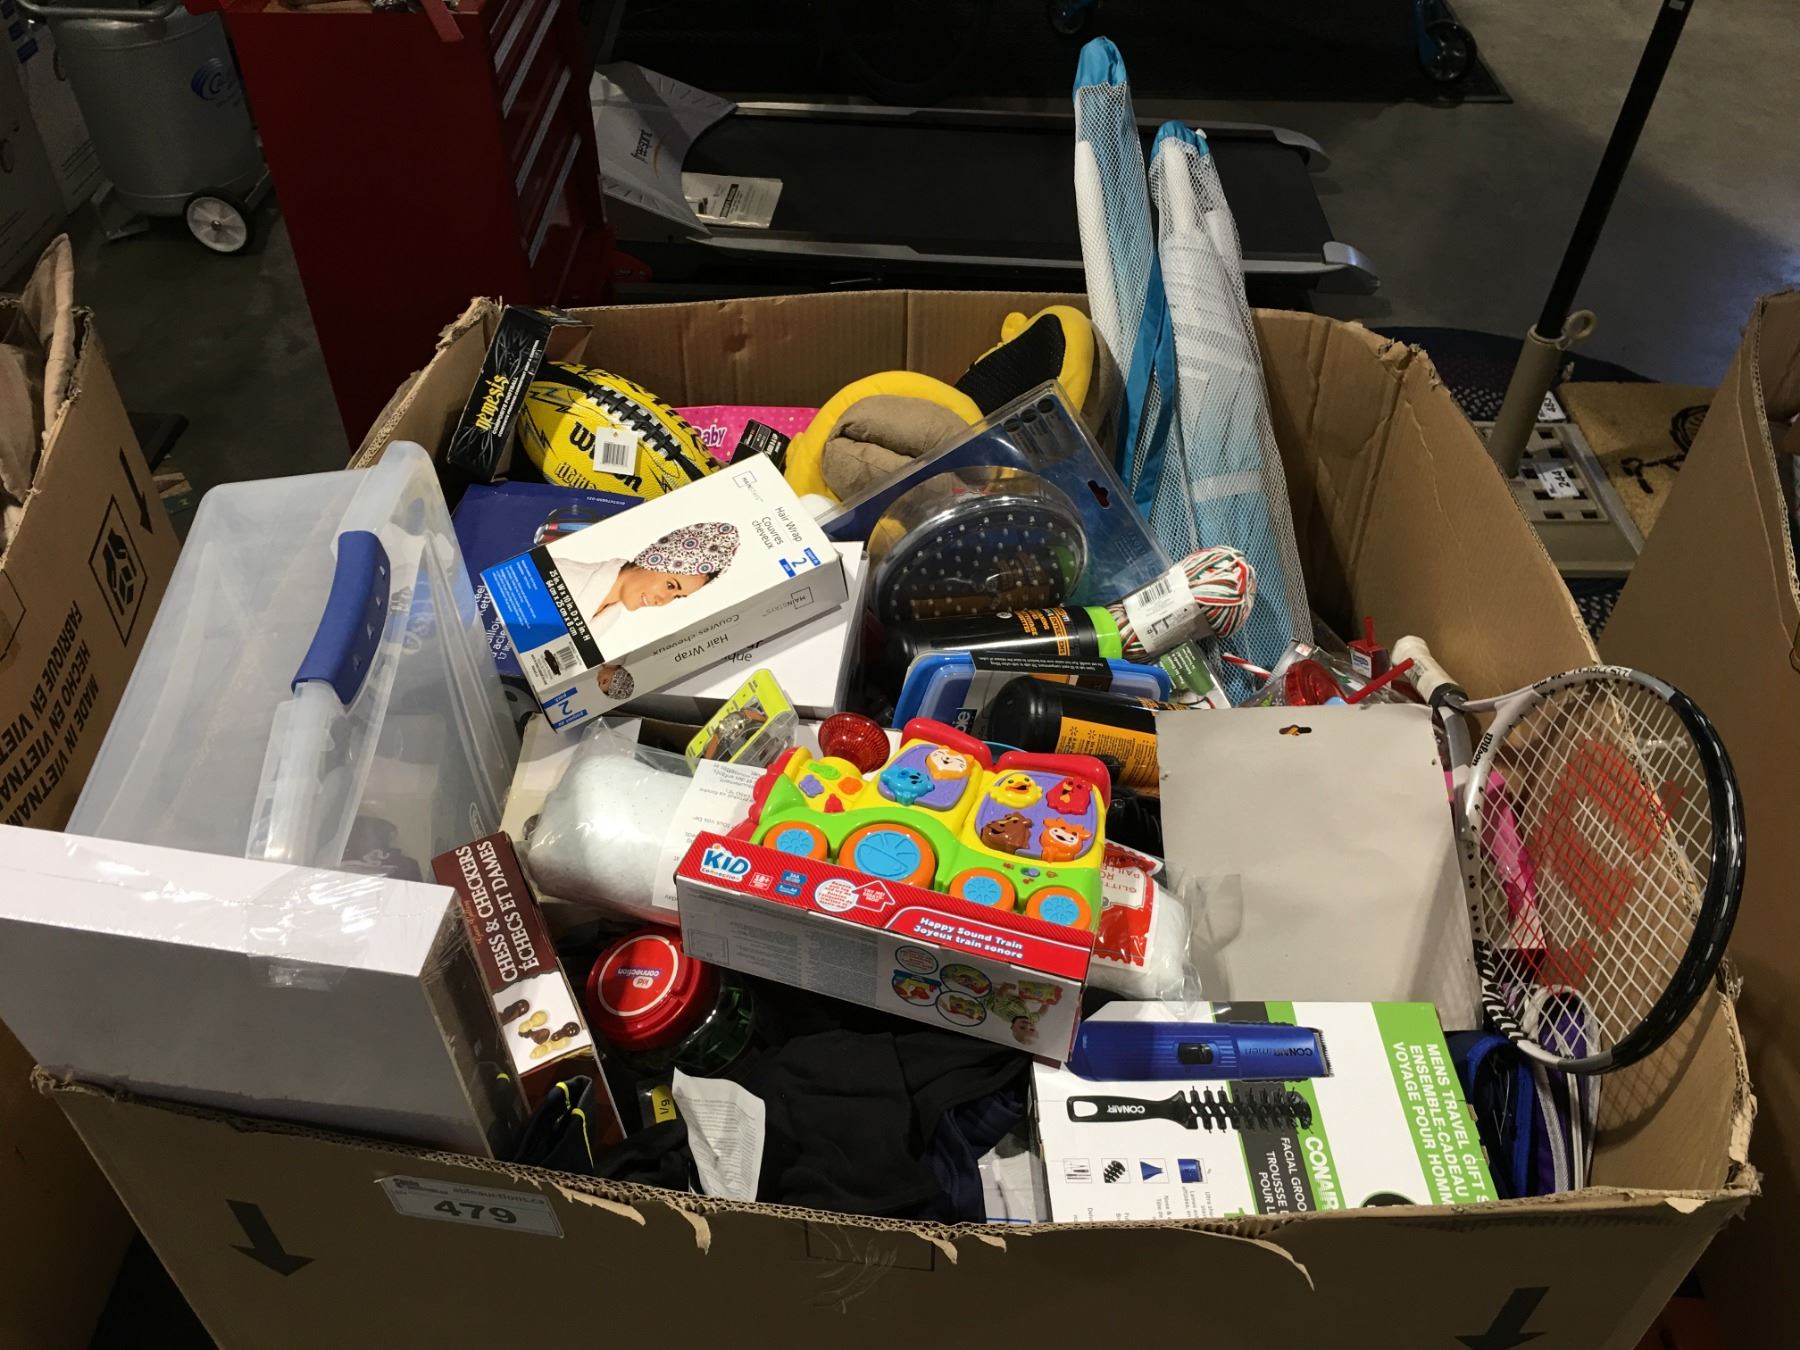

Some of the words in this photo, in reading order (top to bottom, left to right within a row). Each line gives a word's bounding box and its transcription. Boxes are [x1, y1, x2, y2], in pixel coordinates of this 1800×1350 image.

[475, 373, 510, 431] nemesis
[504, 376, 519, 405] FOOTBALL
[1551, 470, 1571, 488] 244
[751, 520, 774, 550] cheveux
[761, 516, 784, 545] Couvres
[775, 506, 791, 522] Hair
[786, 520, 802, 542] Wrap
[549, 569, 557, 578] 25
[791, 557, 808, 568] 2
[545, 580, 554, 588] 64
[549, 587, 557, 597] cm
[557, 582, 565, 591] W
[555, 600, 564, 608] 25
[563, 594, 571, 603] 10
[566, 602, 574, 611] in.
[559, 607, 568, 618] cm
[570, 610, 578, 618] D
[699, 613, 740, 636] Couvres
[569, 626, 578, 637] cm
[578, 625, 587, 635] in.
[583, 633, 591, 642] H
[707, 633, 729, 650] Hair
[41, 600, 83, 693] FABRIQUE
[652, 634, 697, 657] cheveux
[674, 645, 705, 663] Wrap
[60, 638, 91, 708] HECHO
[30, 683, 48, 721] EN
[73, 673, 99, 732] MADE
[559, 700, 573, 716] 2
[49, 698, 66, 737] EN
[64, 723, 79, 755] IN
[1473, 732, 1494, 767] Wilson
[477, 840, 509, 893] DAMES
[703, 850, 749, 875] KID
[455, 845, 494, 918] CHECKERS
[754, 873, 770, 884] 18+
[1104, 882, 1137, 893] GLITT
[495, 892, 517, 913] ET
[485, 918, 500, 933] &
[920, 917, 955, 933] Happy
[957, 927, 992, 942] Sound
[995, 936, 1023, 950] Train
[503, 911, 540, 972] ÉCHECS
[913, 925, 953, 941] Joyeux
[955, 936, 982, 949] train
[984, 945, 1024, 959] sonore
[488, 933, 519, 982] CHESS
[617, 967, 660, 977] connection
[1273, 1047, 1314, 1057] CONAIR
[1393, 1041, 1422, 1102] VOYAGE
[1412, 1104, 1437, 1150] POUR
[1107, 1104, 1146, 1114] CONAIR
[1409, 1044, 1470, 1198] ENSEMBLE-CADEAU
[1426, 1043, 1450, 1087] MENS
[1442, 1089, 1471, 1150] TRAVEL
[1462, 1153, 1486, 1191] GIFT
[1265, 1151, 1288, 1207] TROUSSSE
[1280, 1136, 1298, 1175] FACIAL
[1291, 1177, 1308, 1212] GROO
[1305, 1136, 1340, 1211] CONAIR
[1258, 1171, 1275, 1204] POUR
[434, 1200, 517, 1224] 479
